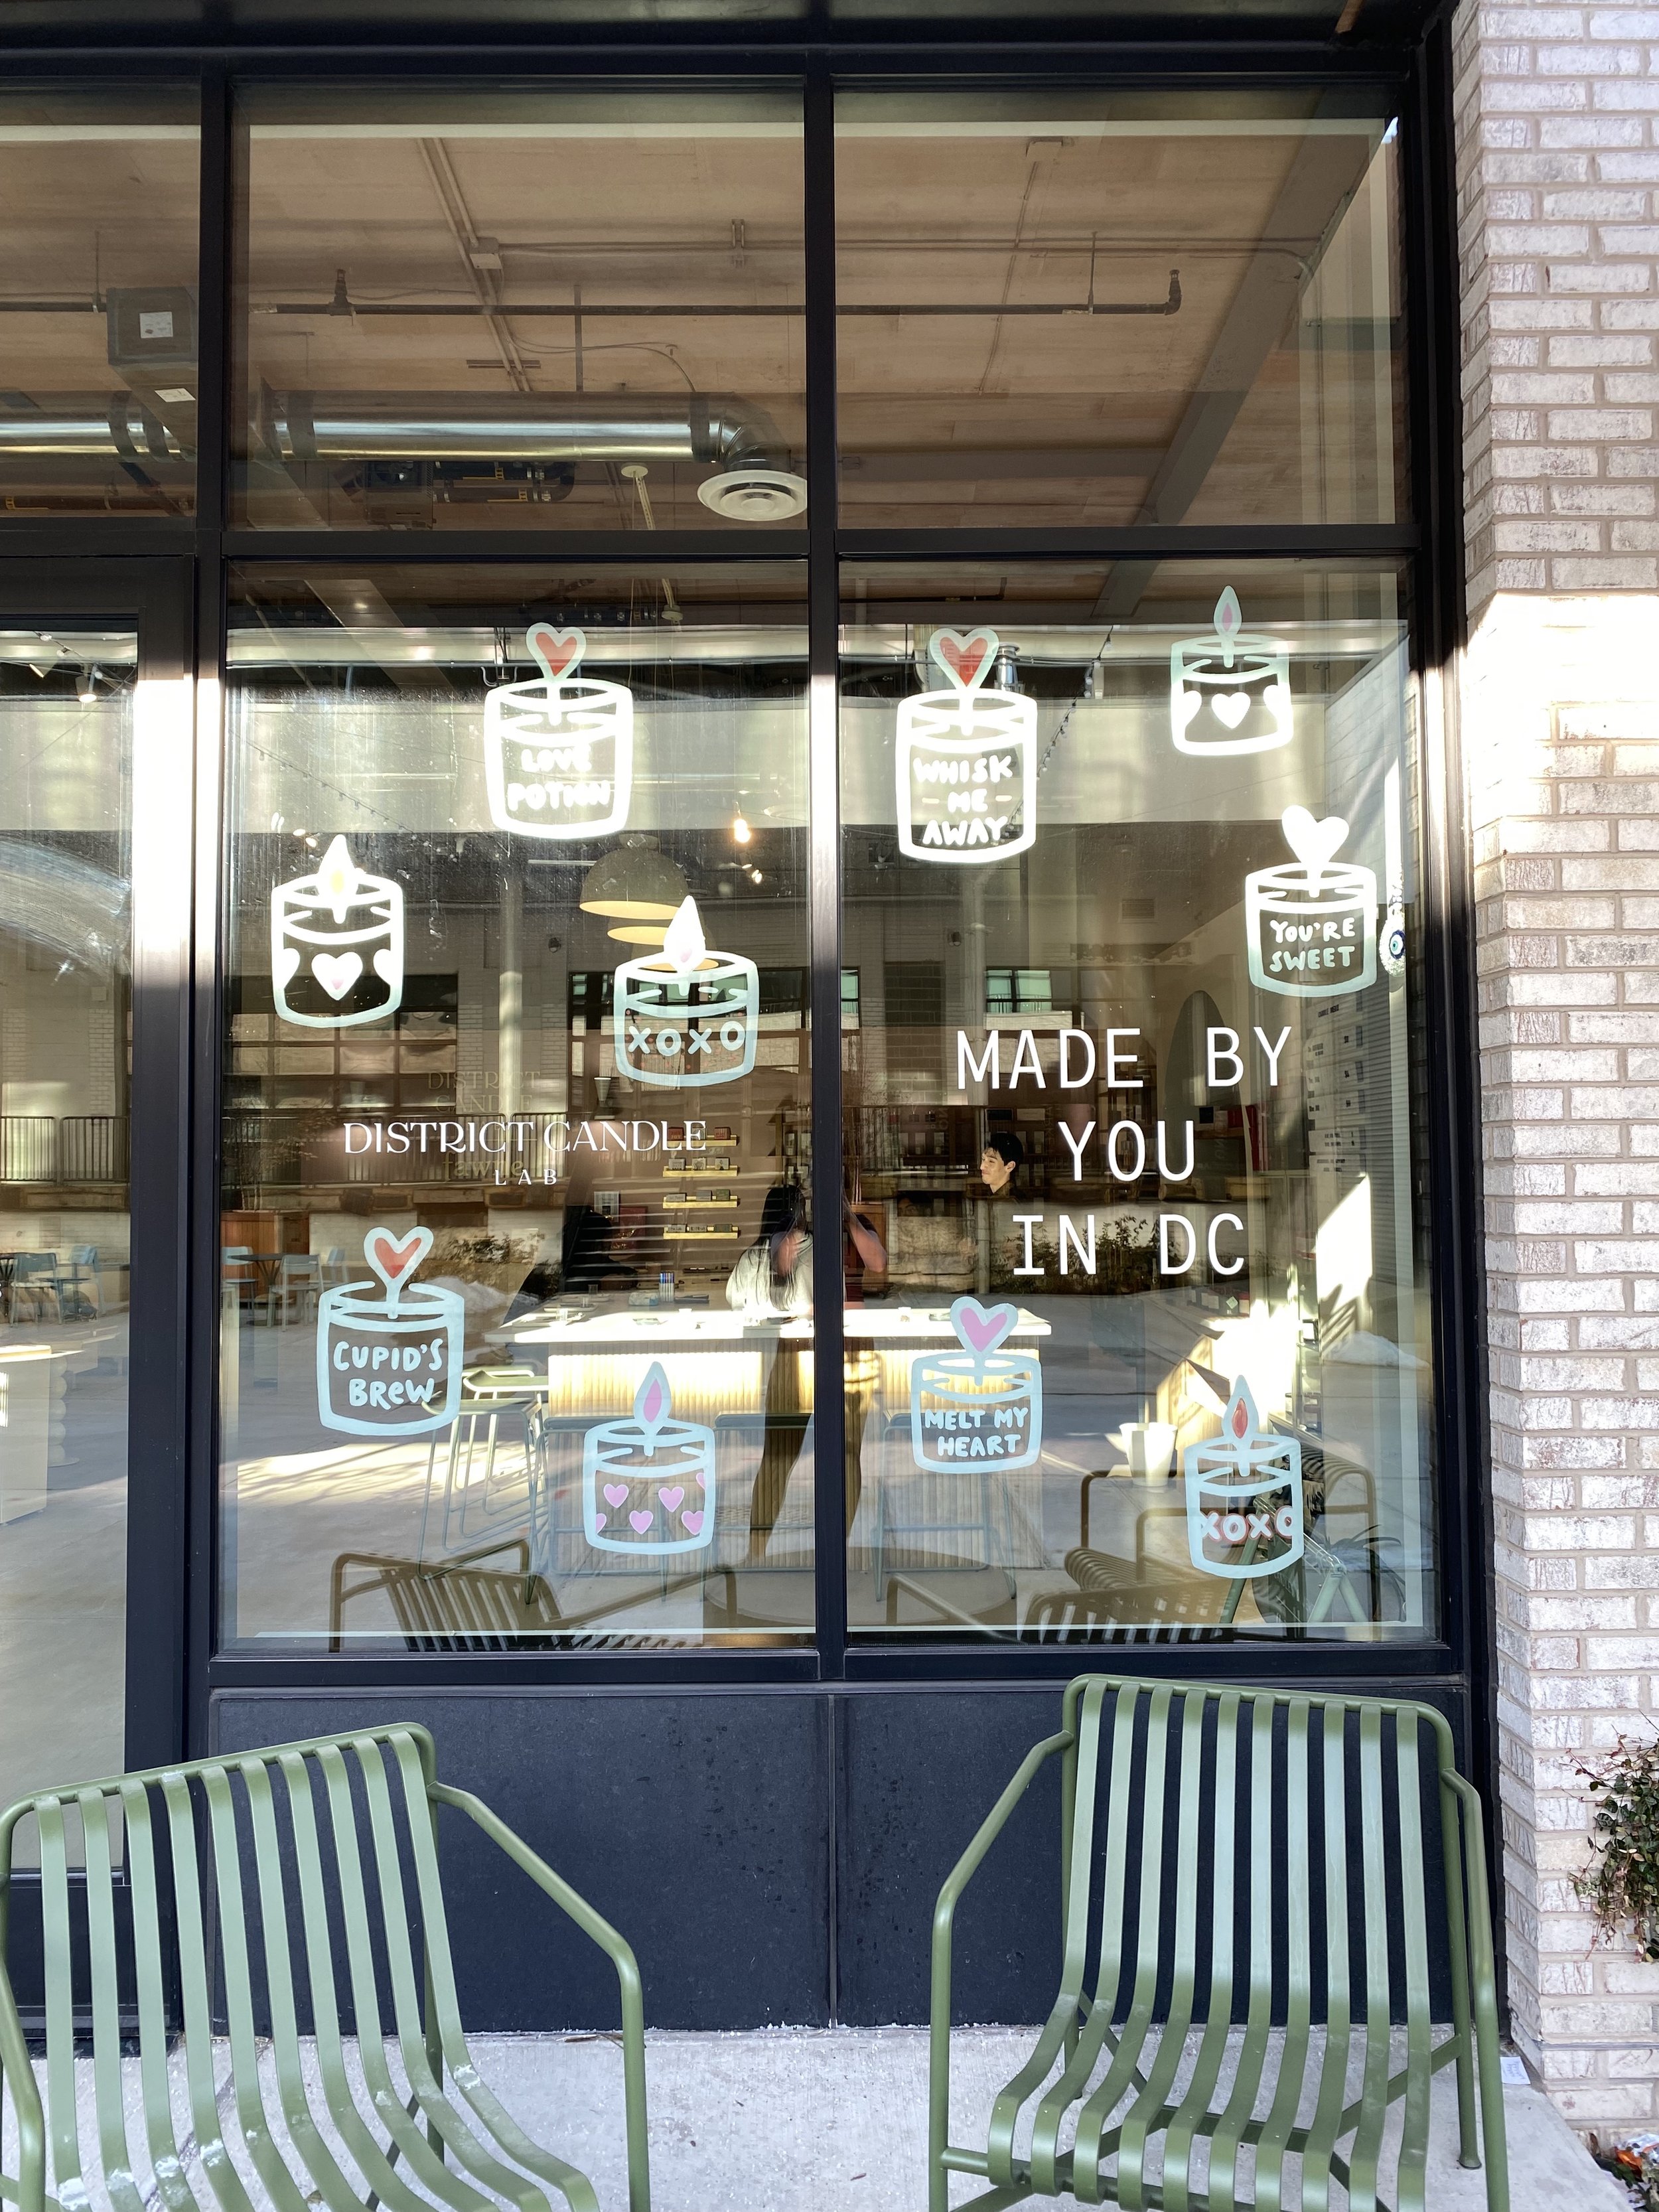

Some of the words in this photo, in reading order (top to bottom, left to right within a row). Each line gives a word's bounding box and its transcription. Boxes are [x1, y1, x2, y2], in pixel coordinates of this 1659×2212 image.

[521, 744, 592, 773] LOVE
[913, 755, 1013, 784] WHISK
[507, 780, 611, 811] POTION
[922, 816, 1008, 846] AWAY
[1269, 917, 1356, 943] YOU'RE
[1269, 946, 1355, 972] SWEET
[628, 1021, 745, 1057] XOXO
[957, 1028, 1143, 1090] MADE
[1206, 1026, 1292, 1087] BY
[343, 1121, 534, 1153] DISTRICT
[543, 1120, 706, 1151] CANDLE
[1058, 1120, 1194, 1181] YOU
[495, 1169, 557, 1185] LAB
[1012, 1215, 1097, 1276] IN
[1159, 1213, 1244, 1276] DC
[333, 1338, 443, 1371] CUPID'S
[925, 1409, 986, 1430] MELT
[994, 1406, 1029, 1428] MY
[938, 1434, 1021, 1457] HEART
[1198, 1506, 1295, 1542] XOXO
